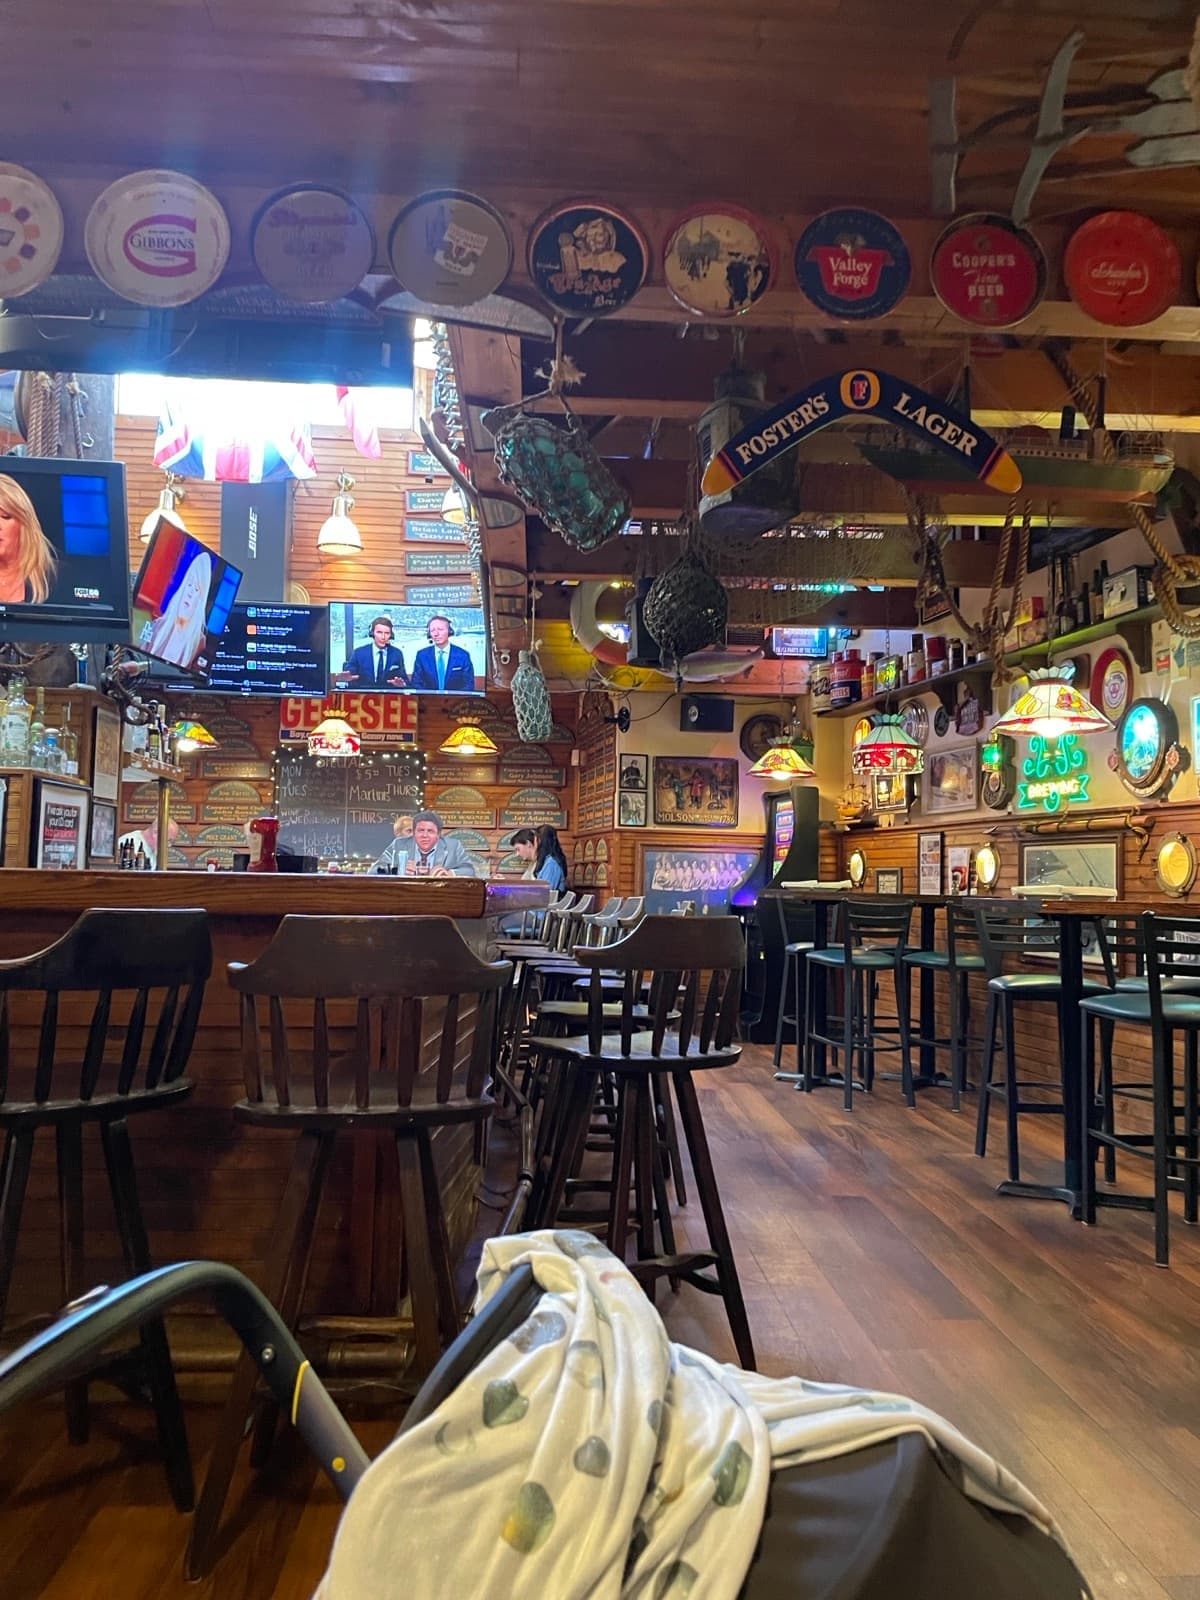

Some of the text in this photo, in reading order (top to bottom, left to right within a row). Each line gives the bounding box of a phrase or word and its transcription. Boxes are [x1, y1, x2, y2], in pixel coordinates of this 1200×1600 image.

[130, 232, 195, 250] GIBBONS
[828, 256, 873, 275] Valley
[832, 271, 869, 289] Forge
[968, 283, 1004, 297] BEER
[735, 392, 831, 465] FOSTER'S
[893, 392, 979, 457] LAGER
[248, 506, 258, 559] BOSE
[281, 765, 302, 777] MON
[385, 765, 410, 777] TUES
[282, 784, 307, 797] TUES
[385, 784, 418, 796] THURS
[658, 812, 695, 822] MOLSON
[720, 815, 736, 824] 1786
